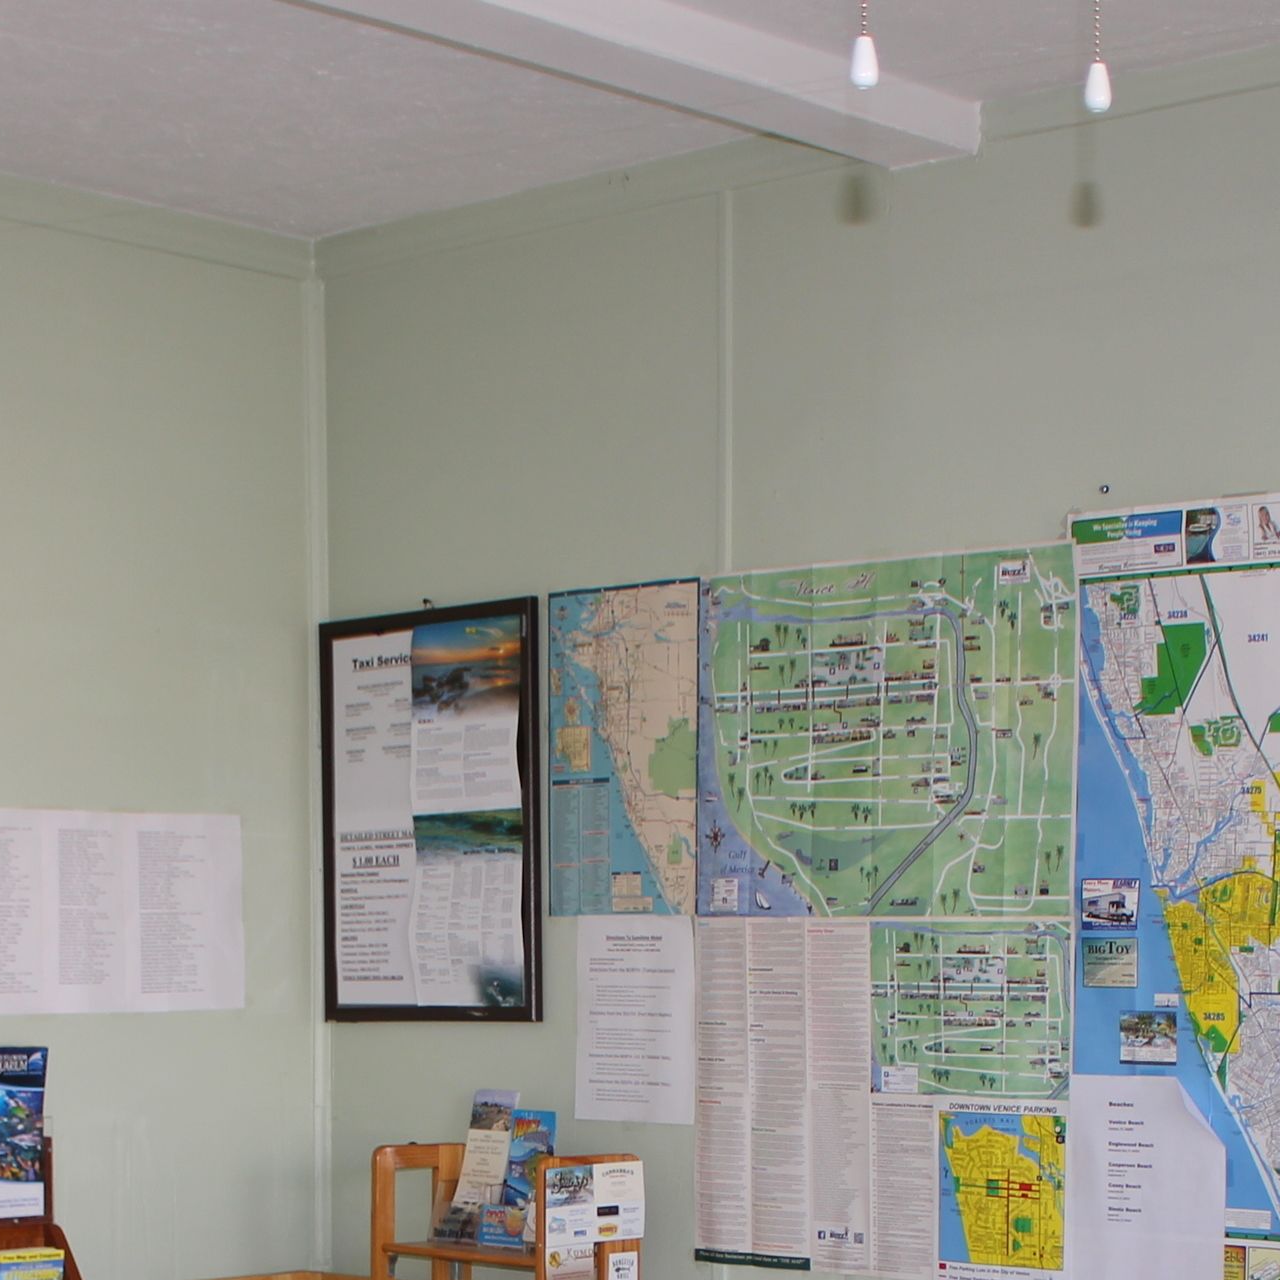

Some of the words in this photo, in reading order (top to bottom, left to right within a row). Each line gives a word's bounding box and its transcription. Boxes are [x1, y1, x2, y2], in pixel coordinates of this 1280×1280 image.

[1247, 632, 1269, 644] 34241
[352, 657, 374, 670] Taxi
[1240, 784, 1262, 796] 34275
[376, 855, 400, 866] EACH
[1202, 1011, 1226, 1022] 34285
[949, 1103, 991, 1112] DOWNTOWN
[993, 1105, 1020, 1113] VENICE
